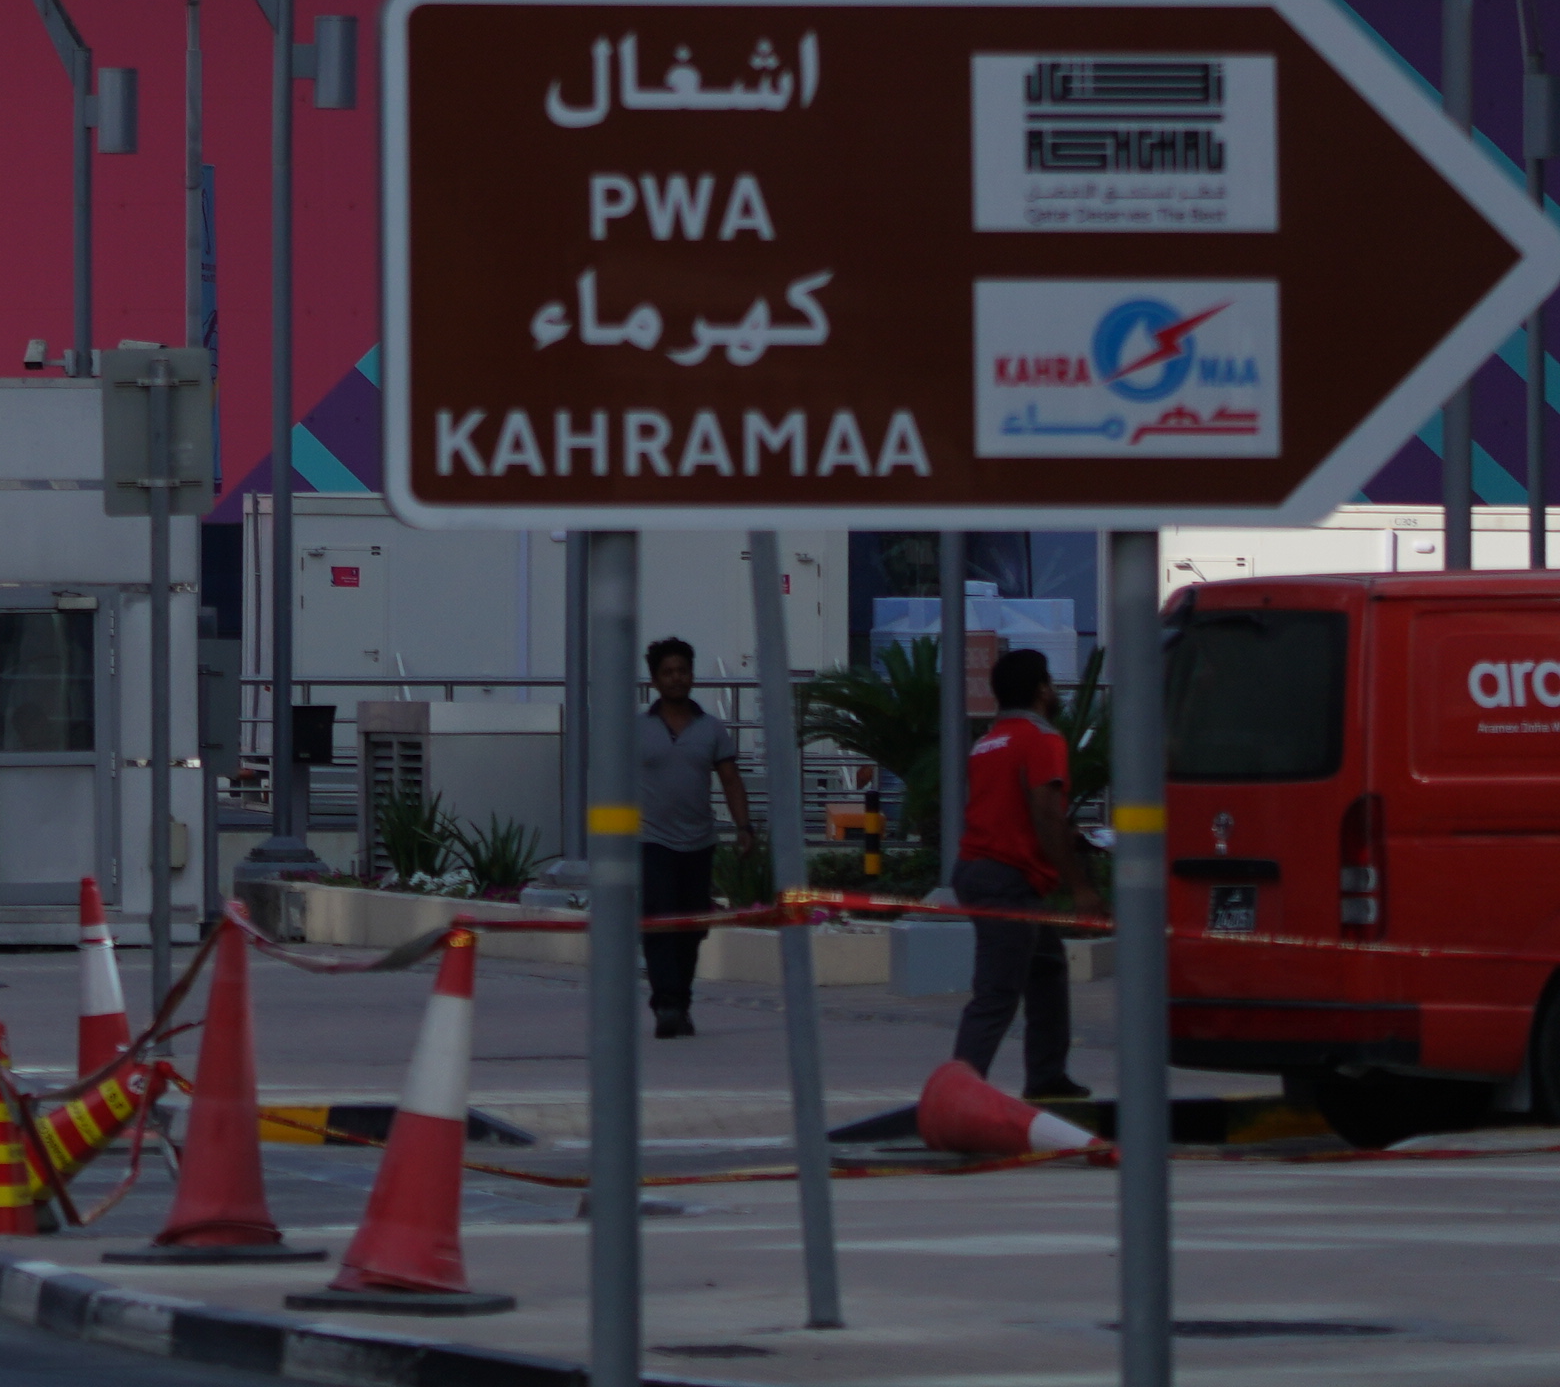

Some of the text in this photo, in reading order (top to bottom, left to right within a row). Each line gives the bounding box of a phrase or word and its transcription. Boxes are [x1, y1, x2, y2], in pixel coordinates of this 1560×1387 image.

[545, 31, 820, 128] اشغال
[588, 172, 775, 241] PWA
[434, 407, 932, 477] KAHRAMAA
